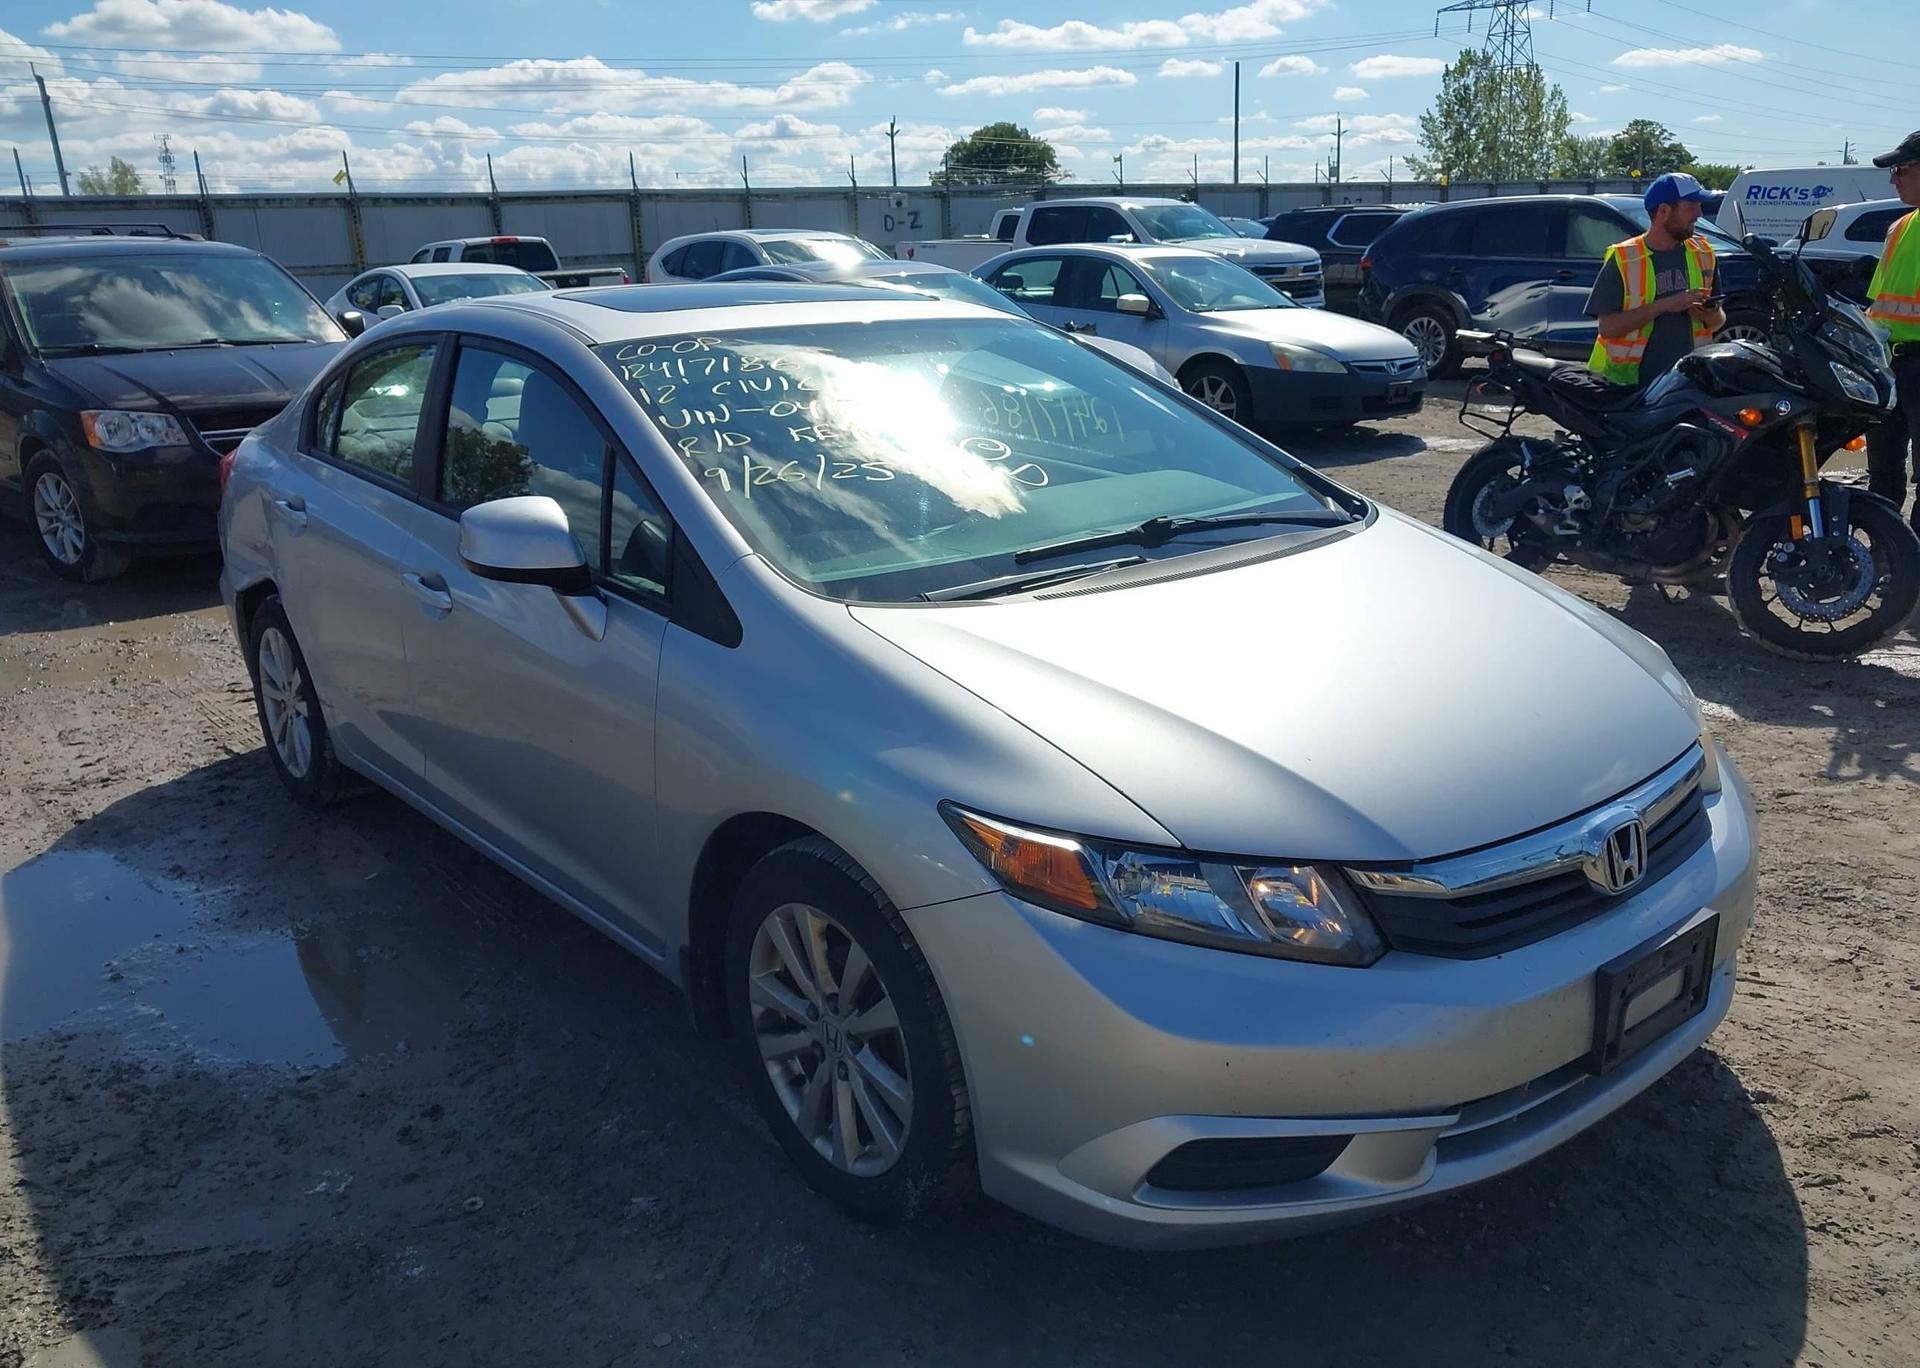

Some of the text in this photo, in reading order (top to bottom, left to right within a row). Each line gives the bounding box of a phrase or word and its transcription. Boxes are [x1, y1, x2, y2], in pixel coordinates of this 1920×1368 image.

[616, 336, 722, 360] CO-OP
[639, 385, 677, 405] 12
[704, 454, 895, 499] 9/26/25
